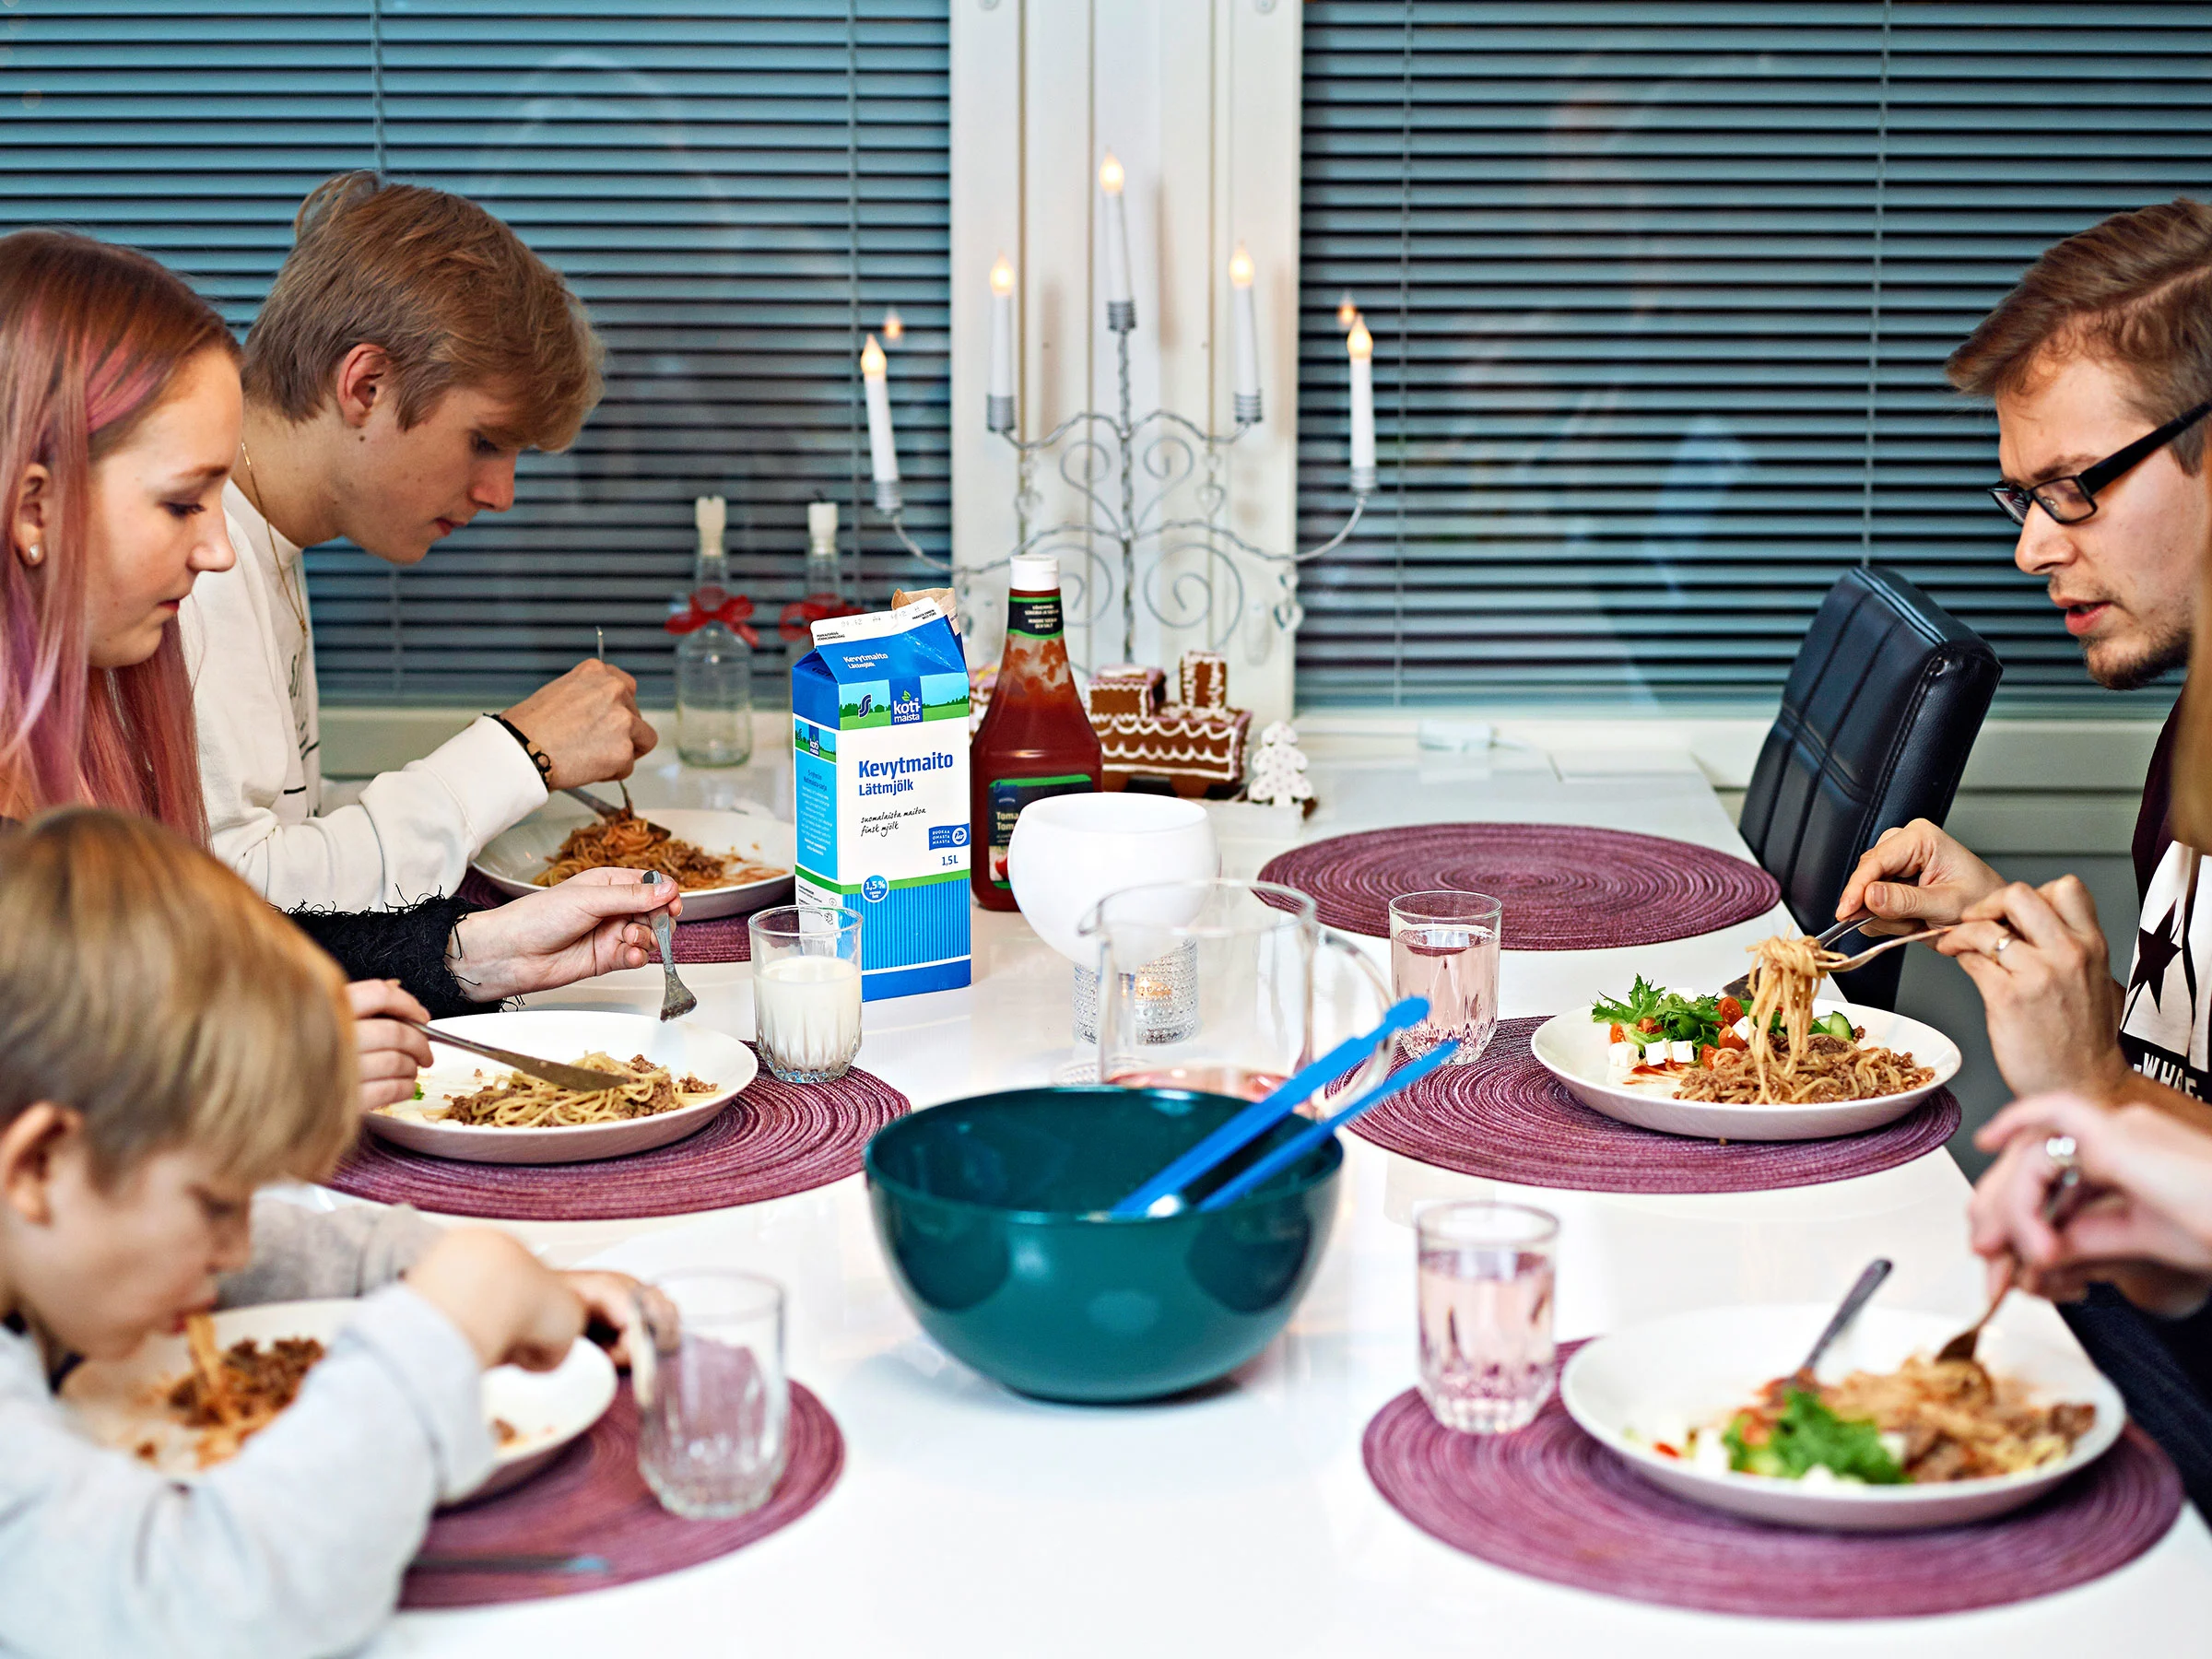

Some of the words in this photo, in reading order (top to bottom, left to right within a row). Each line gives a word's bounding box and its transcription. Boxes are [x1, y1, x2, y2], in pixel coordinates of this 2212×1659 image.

[842, 653, 888, 664] Kevytmaito
[894, 713, 920, 724] maista
[858, 752, 954, 780] Kevytmaito
[858, 779, 913, 796] Lättmjölk
[861, 810, 902, 824] suomalaista
[903, 806, 926, 817] maitoa
[860, 824, 879, 837] finsk
[880, 821, 900, 837] mjölk
[996, 822, 1015, 830] Tom
